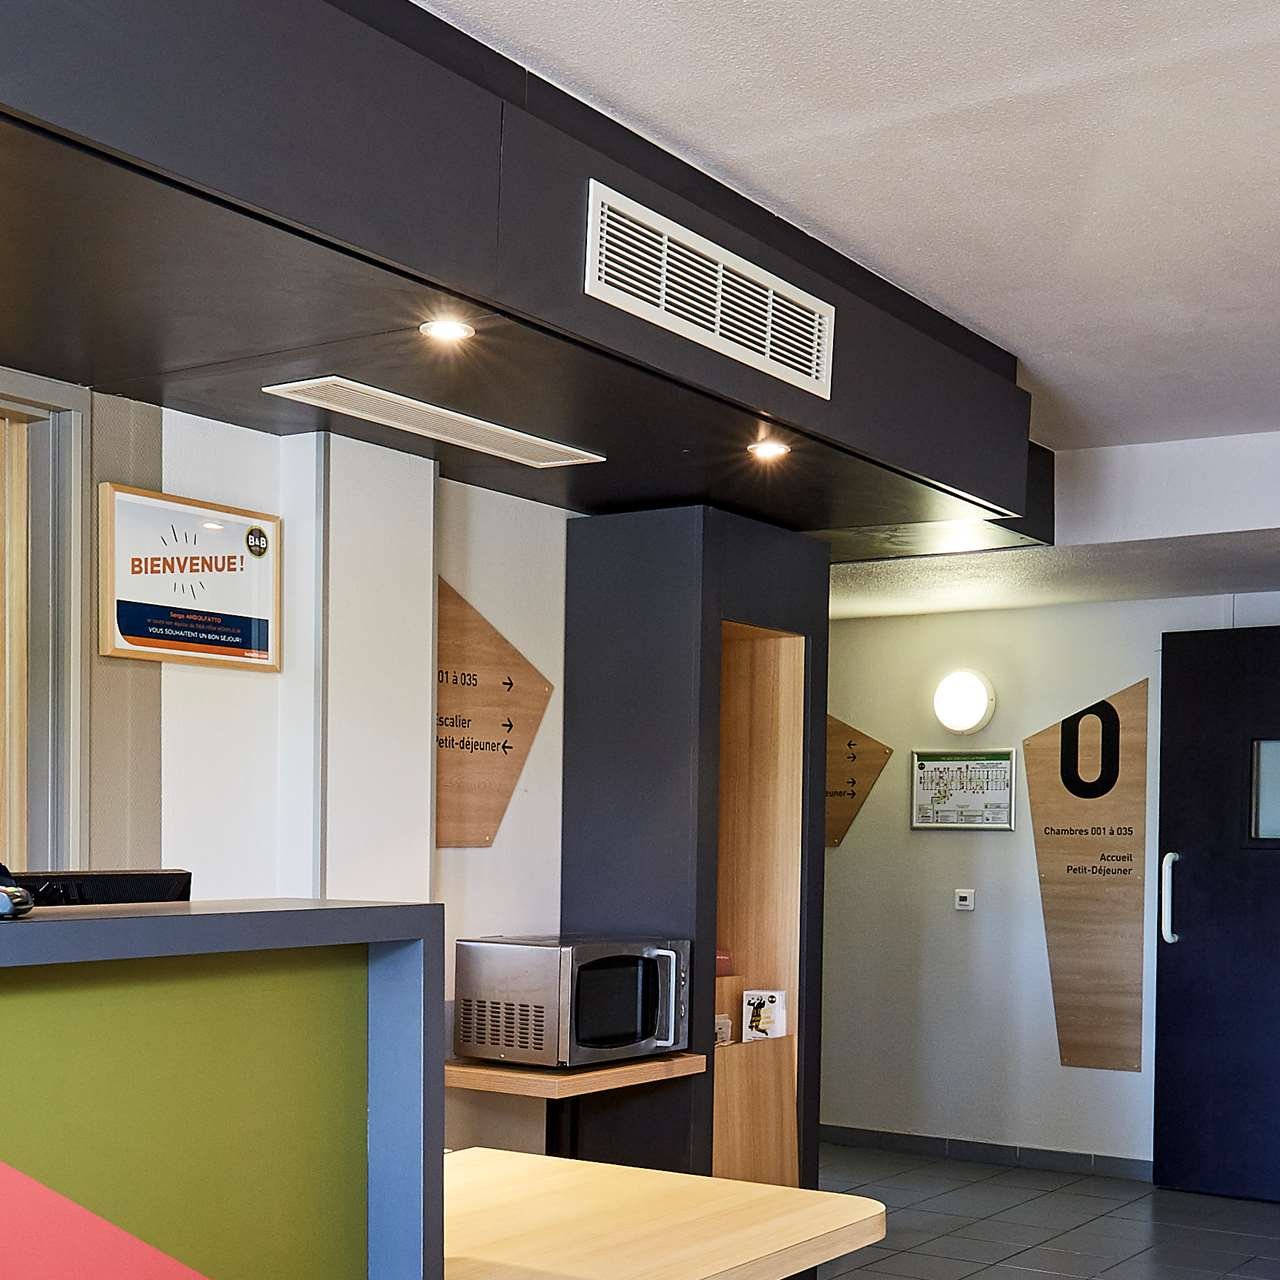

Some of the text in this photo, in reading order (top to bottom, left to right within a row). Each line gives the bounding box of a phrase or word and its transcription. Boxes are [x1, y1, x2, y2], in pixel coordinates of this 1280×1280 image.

[248, 534, 267, 548] B&B
[148, 626, 164, 634] VOUS
[164, 628, 198, 638] SOUHAITENT
[452, 670, 458, 685] à
[460, 672, 478, 687] 035
[1060, 699, 1121, 799] 0
[1043, 826, 1134, 836] Chambres 001 à 035
[1100, 852, 1133, 862] Accueil
[1066, 865, 1134, 877] Petit-Déjeuner
